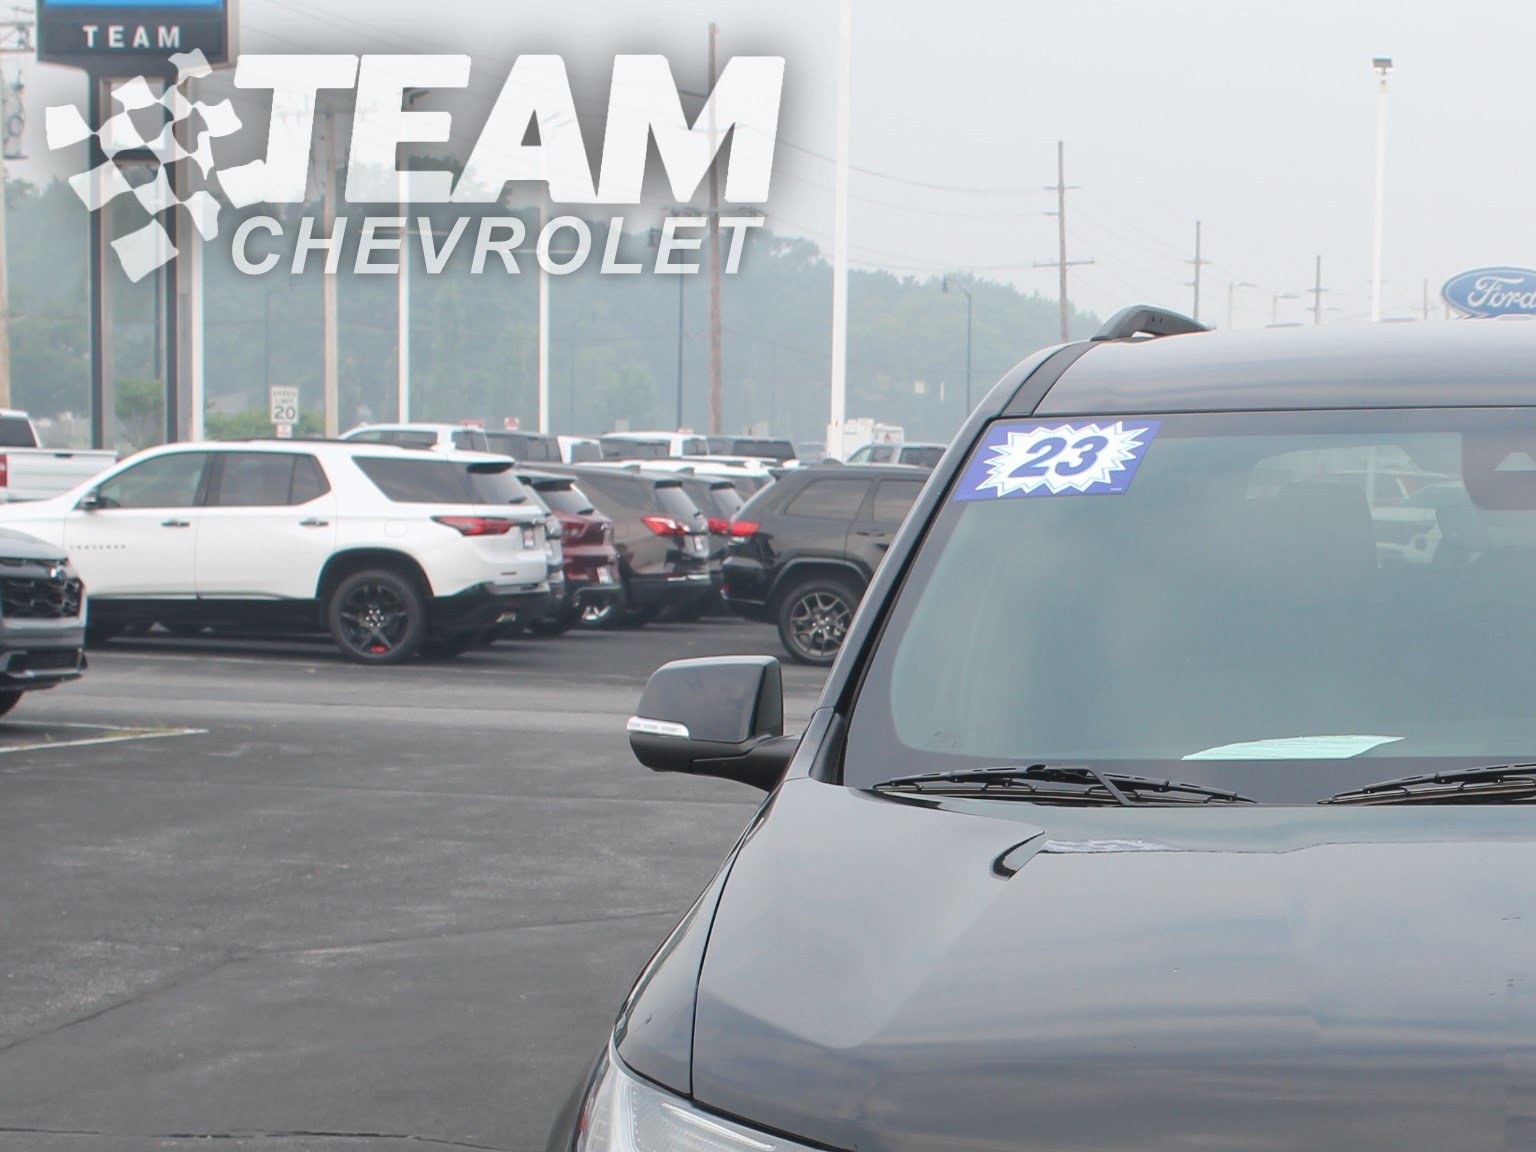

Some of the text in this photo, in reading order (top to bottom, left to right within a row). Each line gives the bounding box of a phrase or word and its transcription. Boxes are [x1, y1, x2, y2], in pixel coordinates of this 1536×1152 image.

[82, 25, 182, 48] TEAM
[274, 405, 296, 420] 20
[1007, 435, 1109, 478] 23
